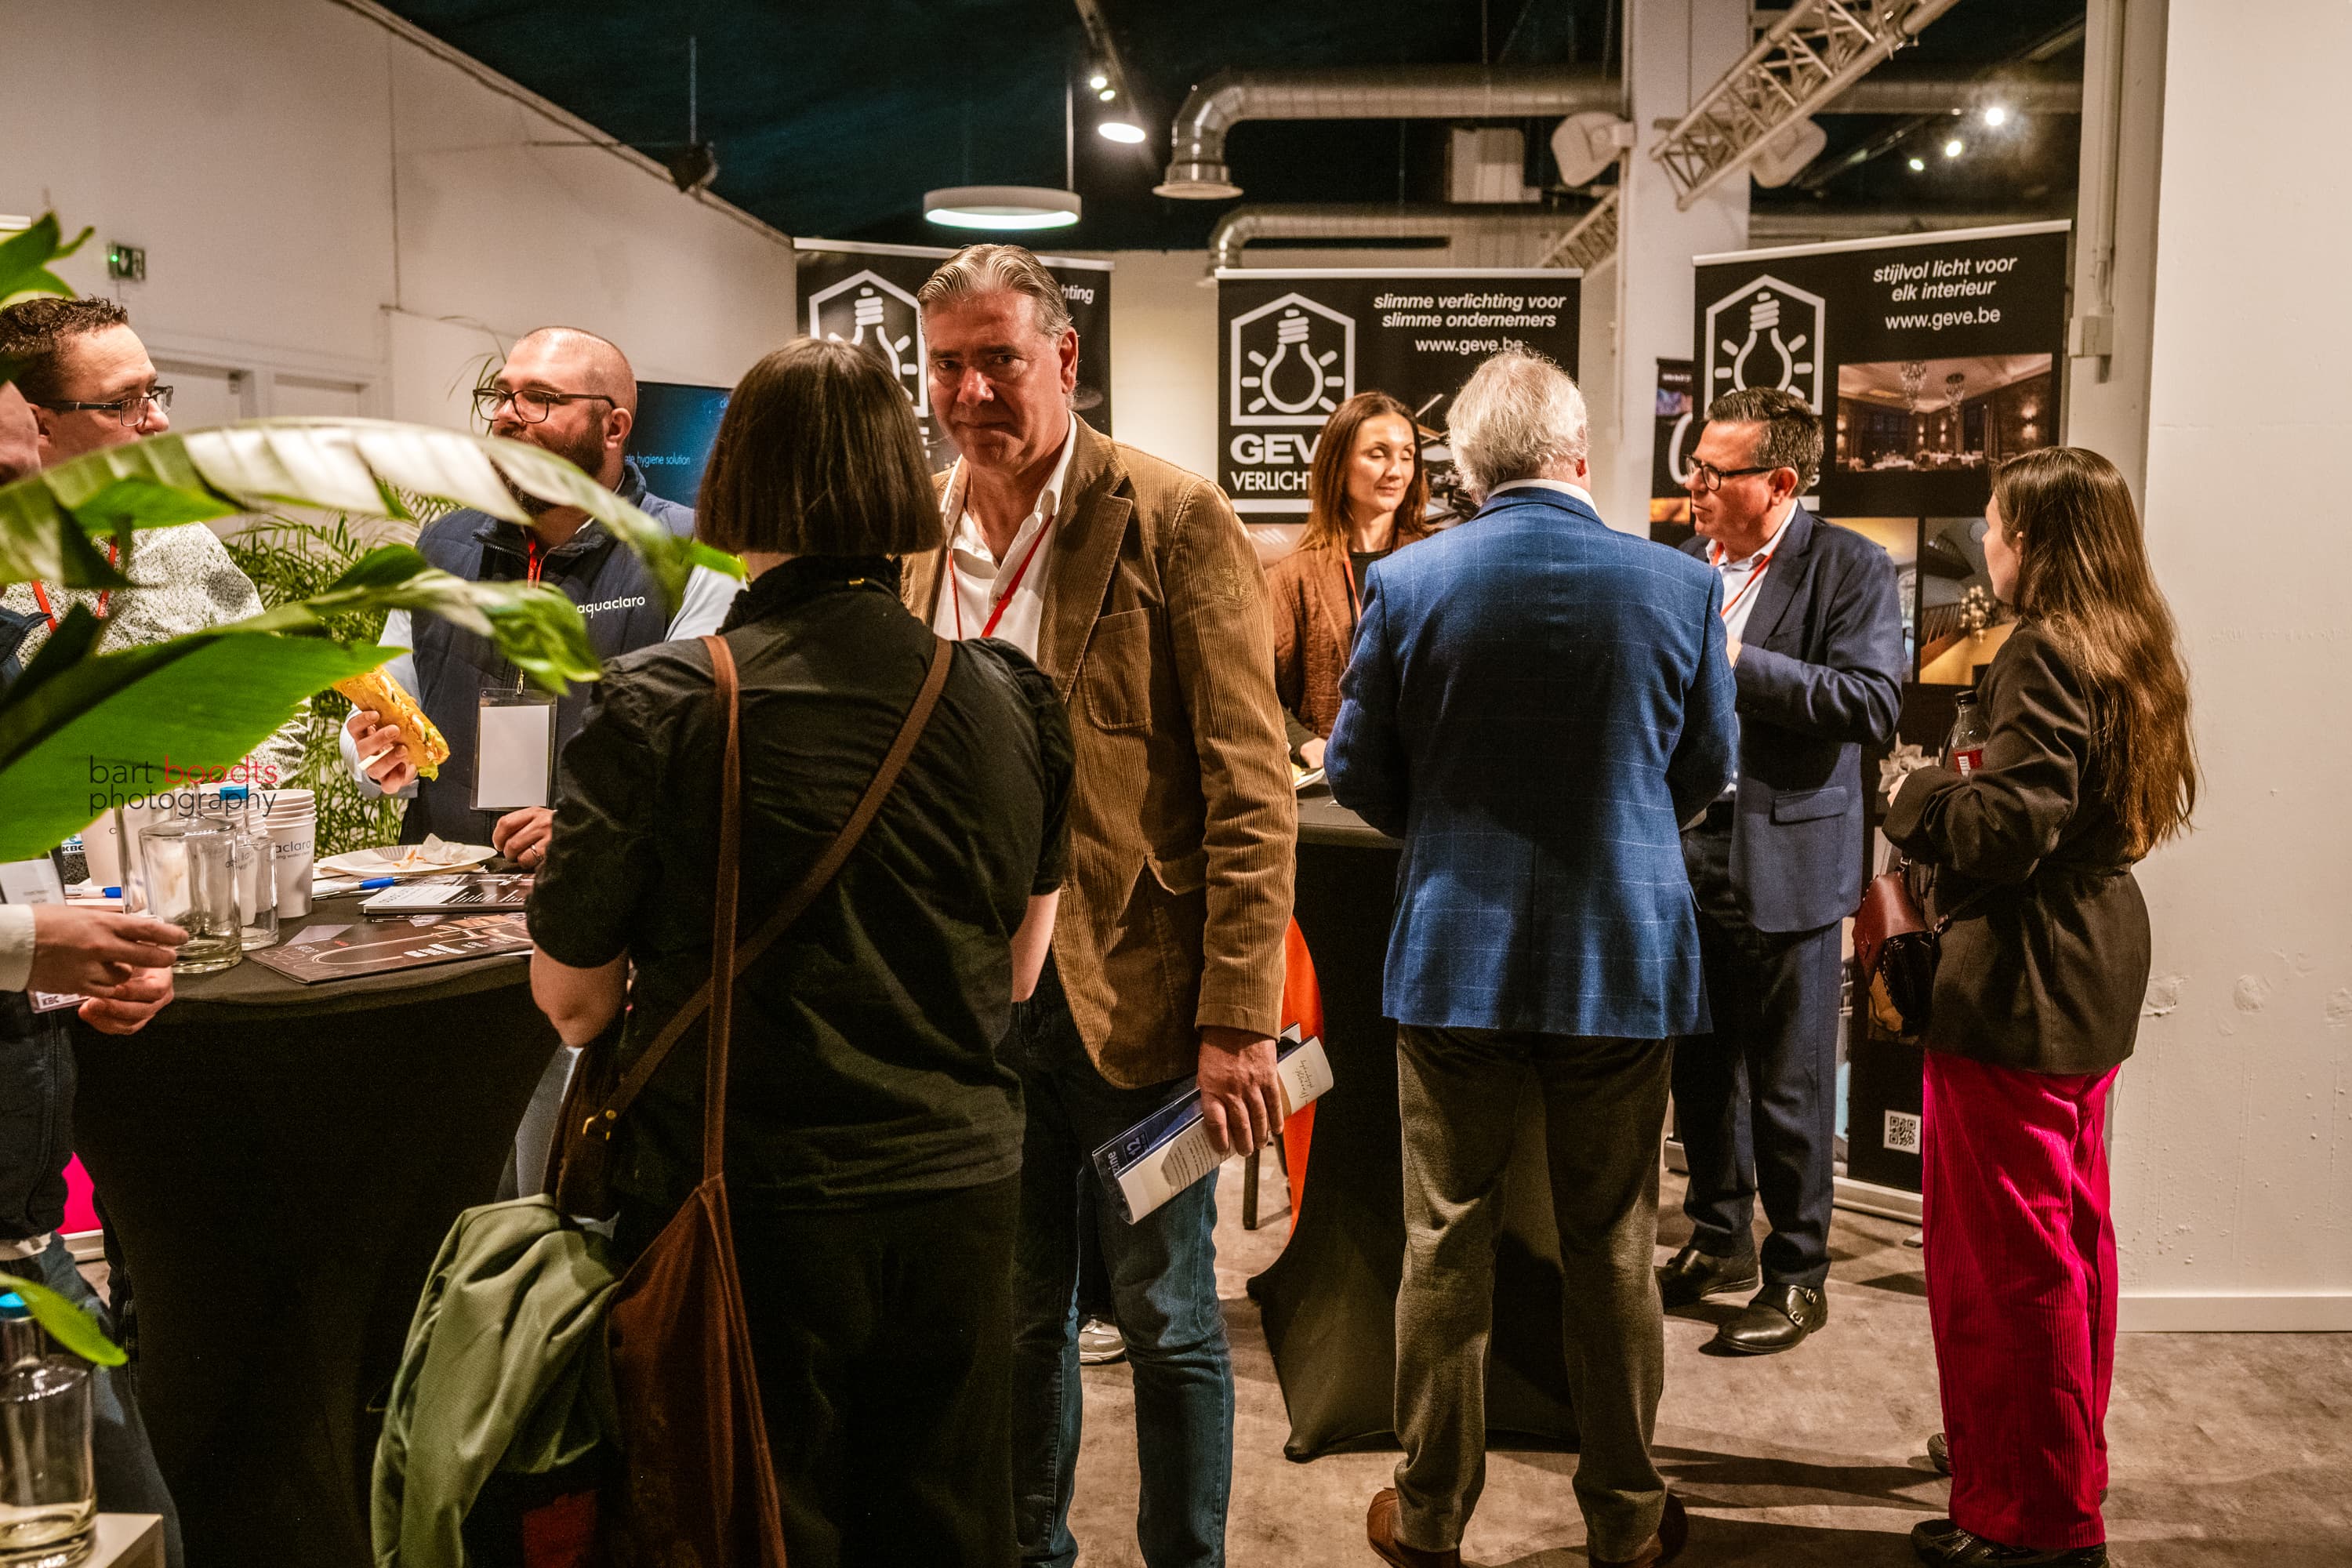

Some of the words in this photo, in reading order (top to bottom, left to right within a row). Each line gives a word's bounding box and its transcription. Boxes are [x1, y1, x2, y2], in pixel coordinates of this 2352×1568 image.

[1873, 261, 1929, 285] stijlvol
[1933, 260, 1972, 278] licht
[1976, 256, 2018, 274] voor
[1891, 283, 1918, 302] elk
[1921, 279, 1997, 300] interieur
[1374, 292, 1434, 309] slimme
[1438, 292, 1524, 312] verlichting
[1527, 296, 1567, 309] voor
[1381, 311, 1443, 328] slimme
[1446, 311, 1557, 328] ondernemers
[1885, 306, 2001, 332] www.geve.be
[1414, 336, 1524, 355] www.geve.be
[637, 451, 664, 468] hygiene
[666, 452, 691, 465] solution
[576, 596, 645, 619] aquaclaro
